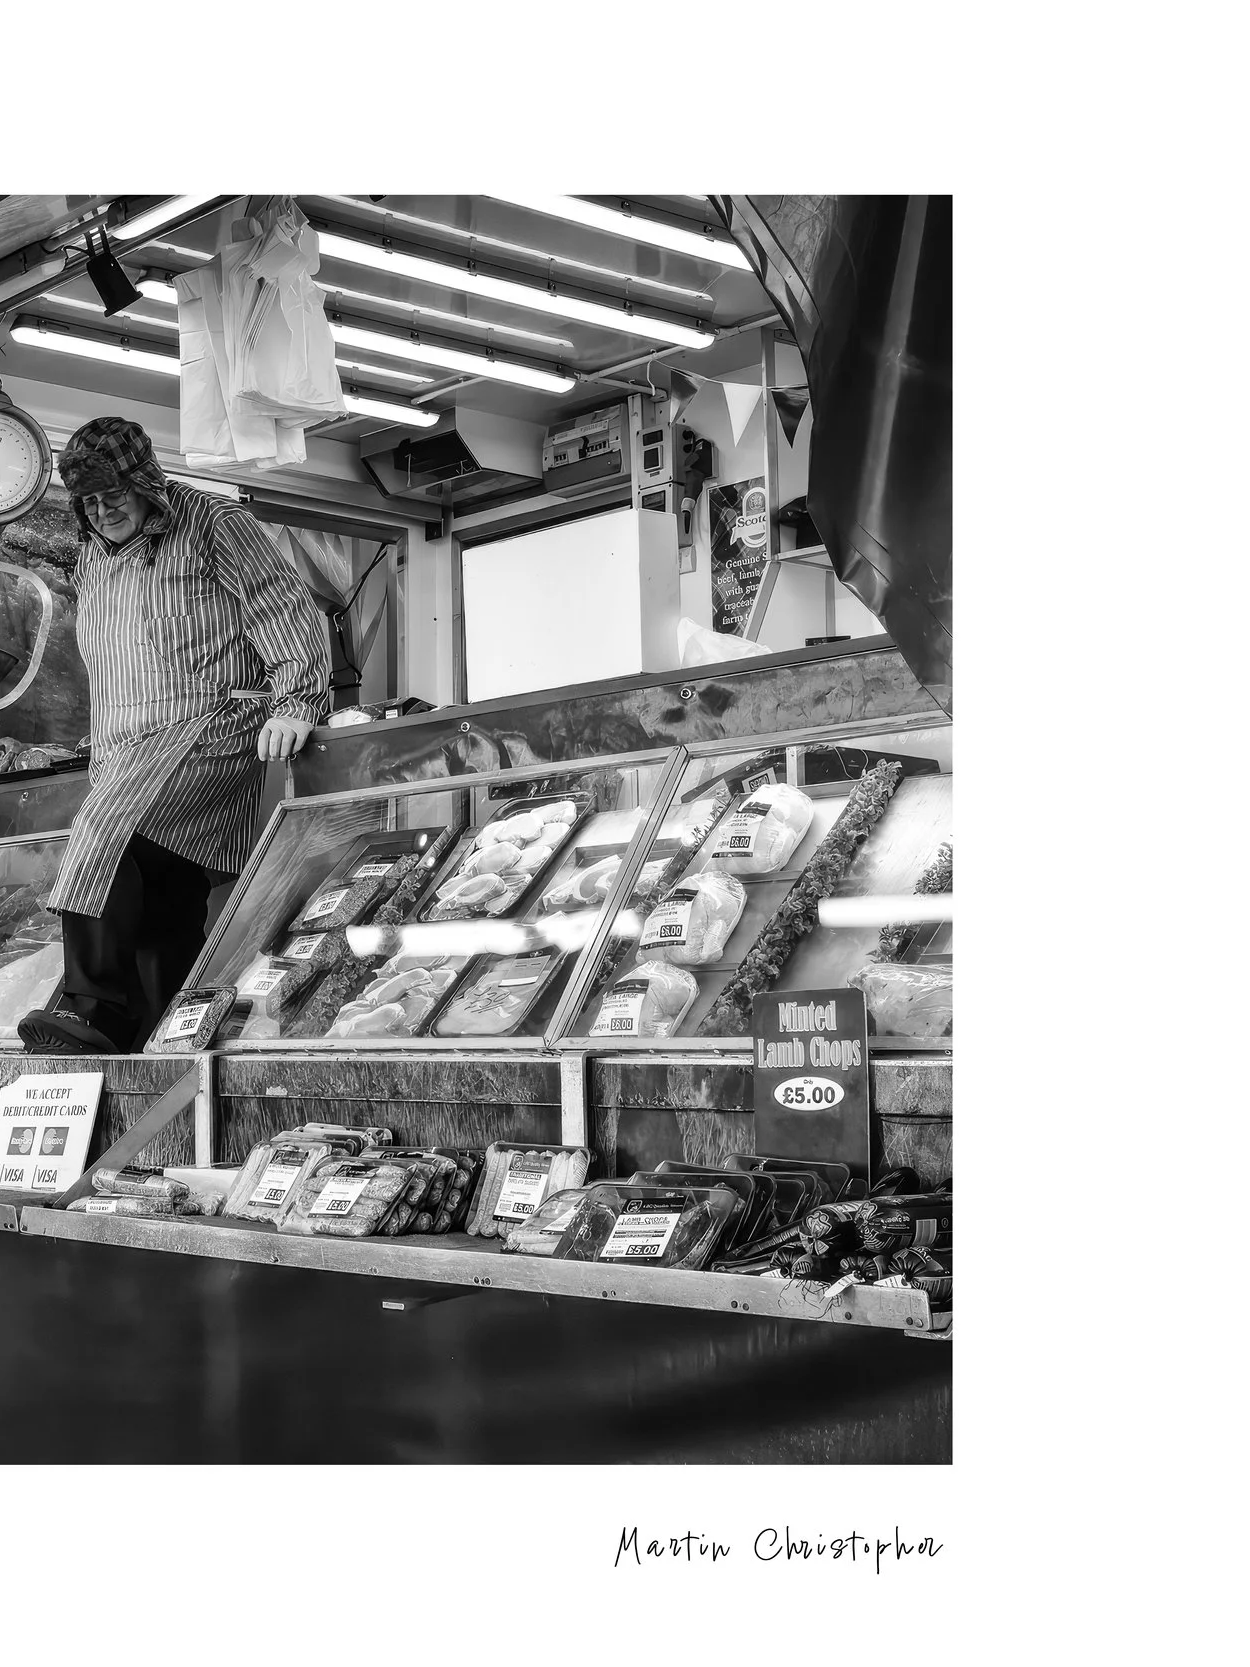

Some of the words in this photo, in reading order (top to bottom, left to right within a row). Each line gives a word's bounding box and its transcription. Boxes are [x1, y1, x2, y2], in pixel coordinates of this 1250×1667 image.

[725, 556, 761, 569] Genuine
[725, 585, 743, 597] with
[722, 615, 744, 625] farm
[778, 1000, 837, 1032] Minted
[757, 1037, 805, 1068] Lamb
[809, 1036, 862, 1071] Chops
[25, 1089, 38, 1100] WE
[39, 1088, 72, 1100] ACCEPT
[782, 1086, 836, 1105] £5.00
[2, 1105, 59, 1117] DEBIT/CREDIT
[59, 1104, 88, 1116] CARDS
[4, 1168, 25, 1182] VISA
[37, 1169, 58, 1184] VISA
[513, 1203, 535, 1214] £5.00
[626, 1245, 659, 1255] £5.00
